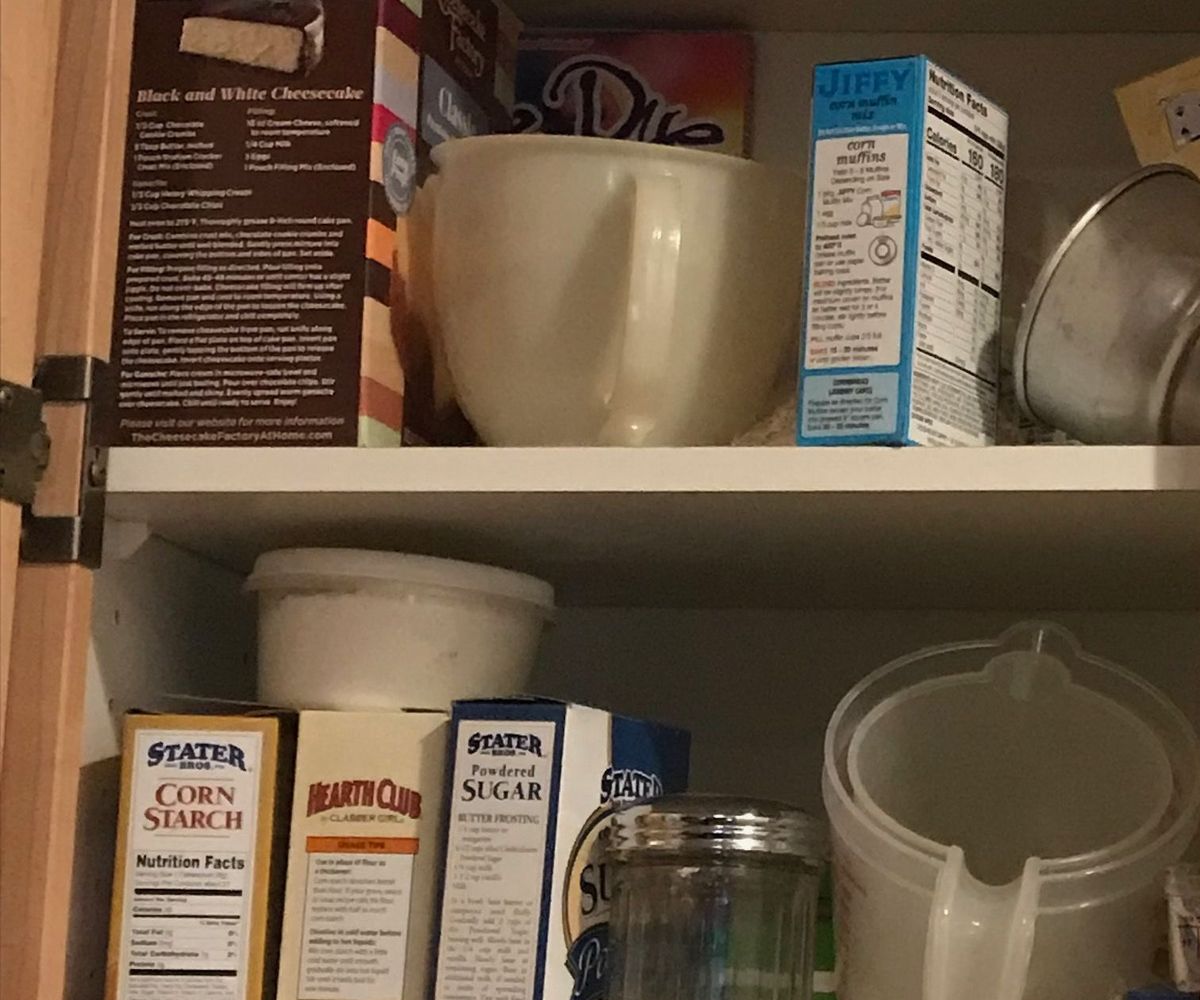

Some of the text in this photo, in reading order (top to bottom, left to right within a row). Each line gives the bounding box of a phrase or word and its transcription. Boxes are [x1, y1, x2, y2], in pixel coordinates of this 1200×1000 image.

[137, 86, 364, 102] Black and White Cheesecake
[818, 68, 911, 98] JIFFY
[928, 68, 988, 118] Nutrition Facts
[847, 140, 876, 151] corn
[926, 126, 958, 155] Calories
[836, 152, 887, 165] muffins
[147, 741, 248, 772] STATER
[467, 731, 543, 758] STATER
[471, 764, 536, 778] Powdered
[155, 783, 236, 807] CORN
[306, 778, 423, 819] HEARTH CLUB
[461, 779, 542, 802] SUGAR
[142, 807, 243, 831] STARCH
[458, 813, 540, 825] BUTTER FROSTING
[136, 854, 245, 870] Nutrition Facts
